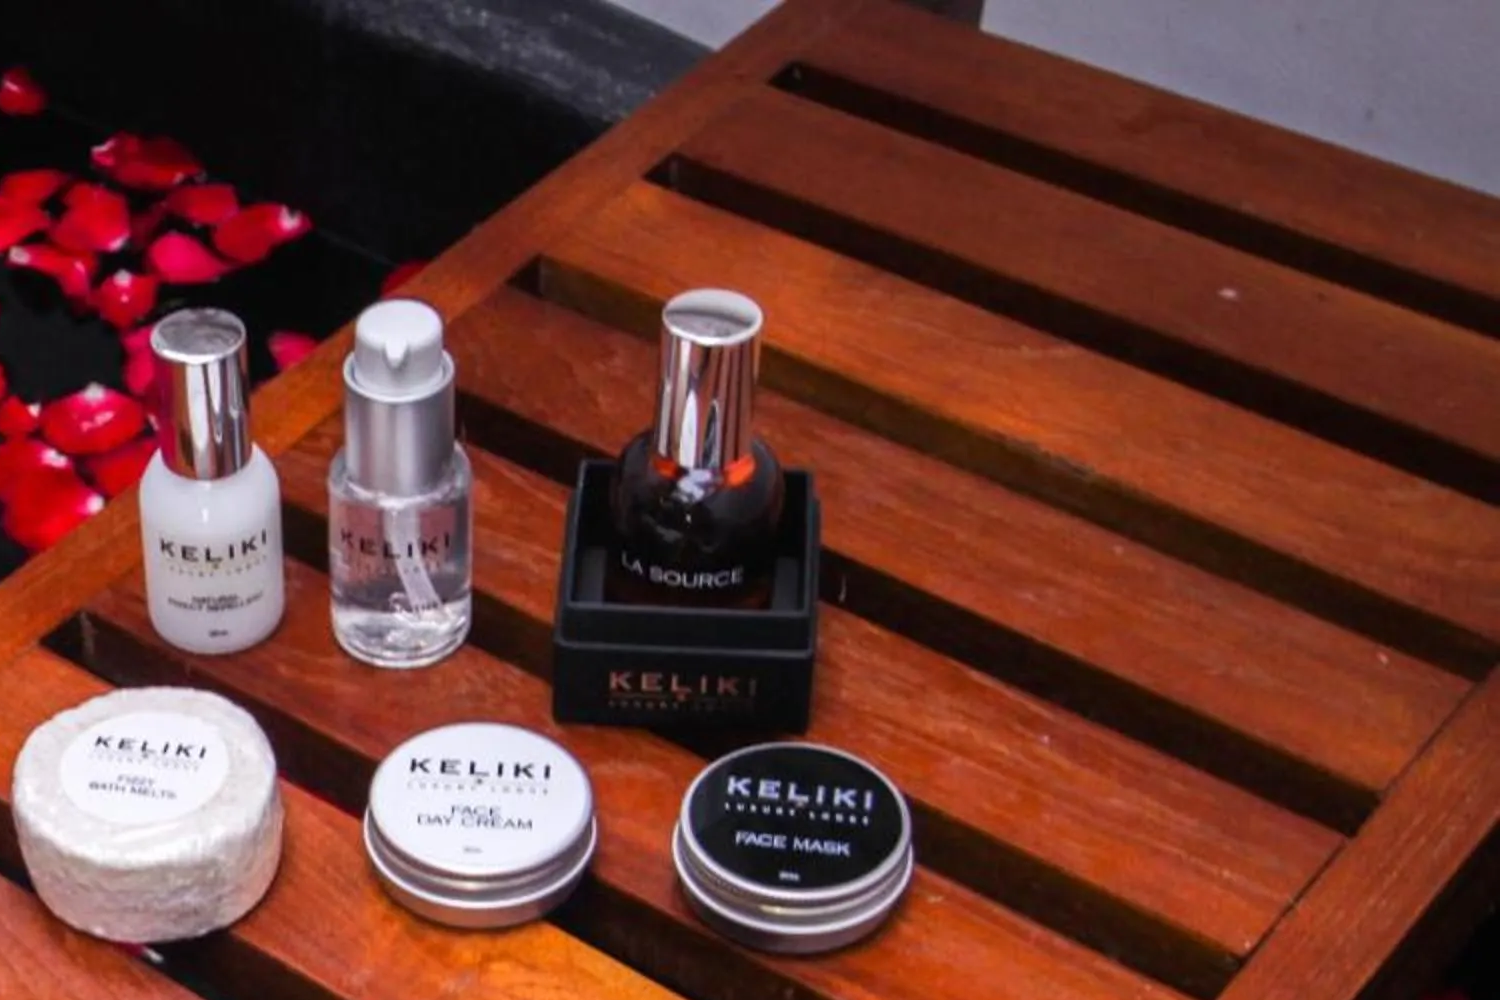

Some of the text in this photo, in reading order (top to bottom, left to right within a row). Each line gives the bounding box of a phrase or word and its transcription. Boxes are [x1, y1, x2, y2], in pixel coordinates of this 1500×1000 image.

[160, 528, 267, 562] KELIKI
[341, 528, 449, 560] KELIKI
[622, 550, 744, 589] LA SOURCE
[609, 670, 757, 697] KELIKI
[94, 736, 207, 760] KELIKI
[409, 757, 551, 780] KELIKI
[727, 776, 874, 811] KELIKI
[417, 814, 534, 831] DAY CREAM
[451, 805, 501, 817] FACE
[734, 830, 851, 859] FACE MASK
